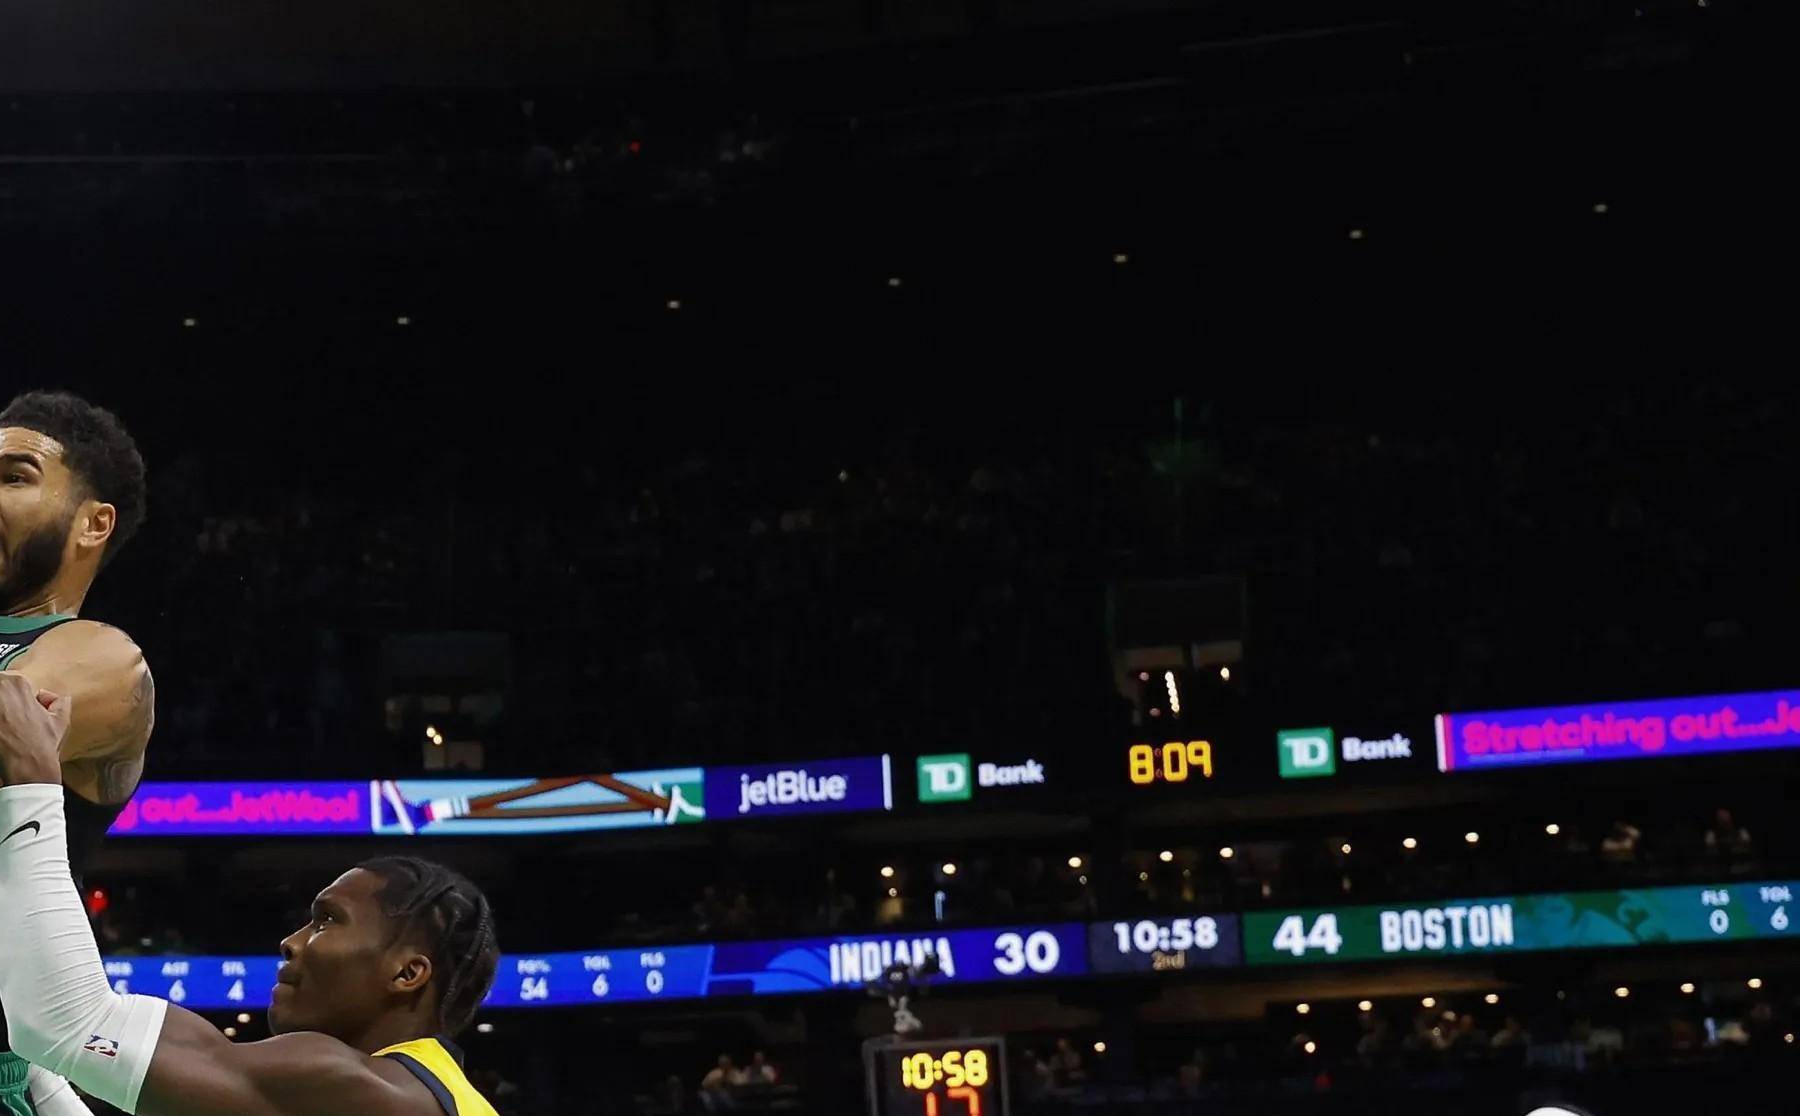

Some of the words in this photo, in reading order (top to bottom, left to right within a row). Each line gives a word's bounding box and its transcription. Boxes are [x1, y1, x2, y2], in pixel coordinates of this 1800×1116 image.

[1282, 736, 1330, 768] TD
[1342, 733, 1412, 761] Bank
[1463, 713, 1665, 753] Stretching
[922, 762, 966, 793] TD
[977, 759, 1045, 787] Bank
[1129, 740, 1212, 783] 8:09
[738, 769, 847, 814] jetBlue
[1114, 916, 1218, 953] 10:58
[1273, 913, 1342, 956] 44
[1380, 903, 1514, 953] BOSTON
[1708, 908, 1728, 934] 0
[1770, 904, 1789, 931] 6
[993, 930, 1060, 975] 30
[168, 978, 186, 1002] 6
[226, 978, 246, 1002] 4
[520, 976, 548, 1000] 54
[591, 972, 609, 997] 6
[645, 969, 664, 994] 0
[902, 1049, 988, 1089] 10:58
